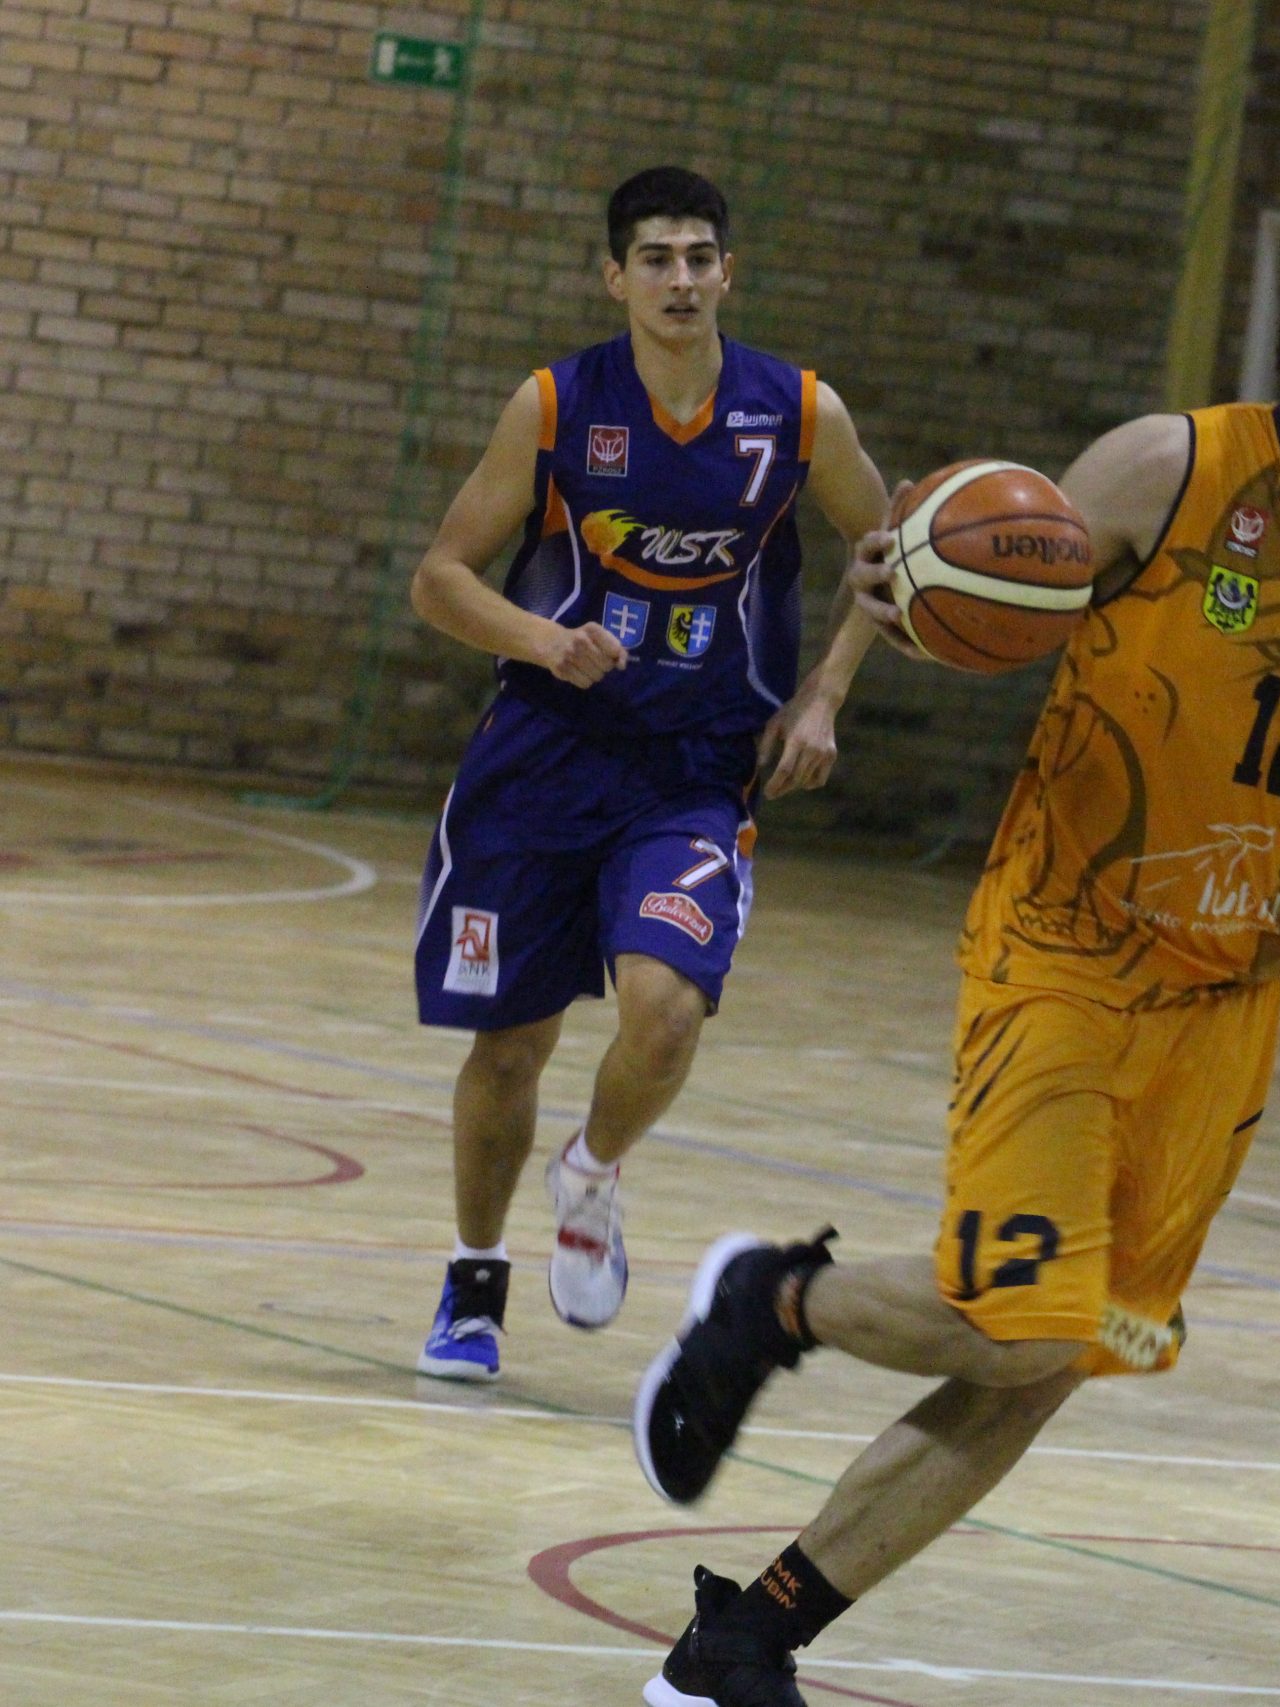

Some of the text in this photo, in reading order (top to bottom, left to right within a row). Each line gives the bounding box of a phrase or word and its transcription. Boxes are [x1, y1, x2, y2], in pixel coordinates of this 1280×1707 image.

[735, 434, 776, 506] 7
[640, 527, 744, 567] WSK
[672, 838, 731, 891] 7
[957, 1210, 1059, 1300] 12
[761, 1569, 797, 1609] UBIN
